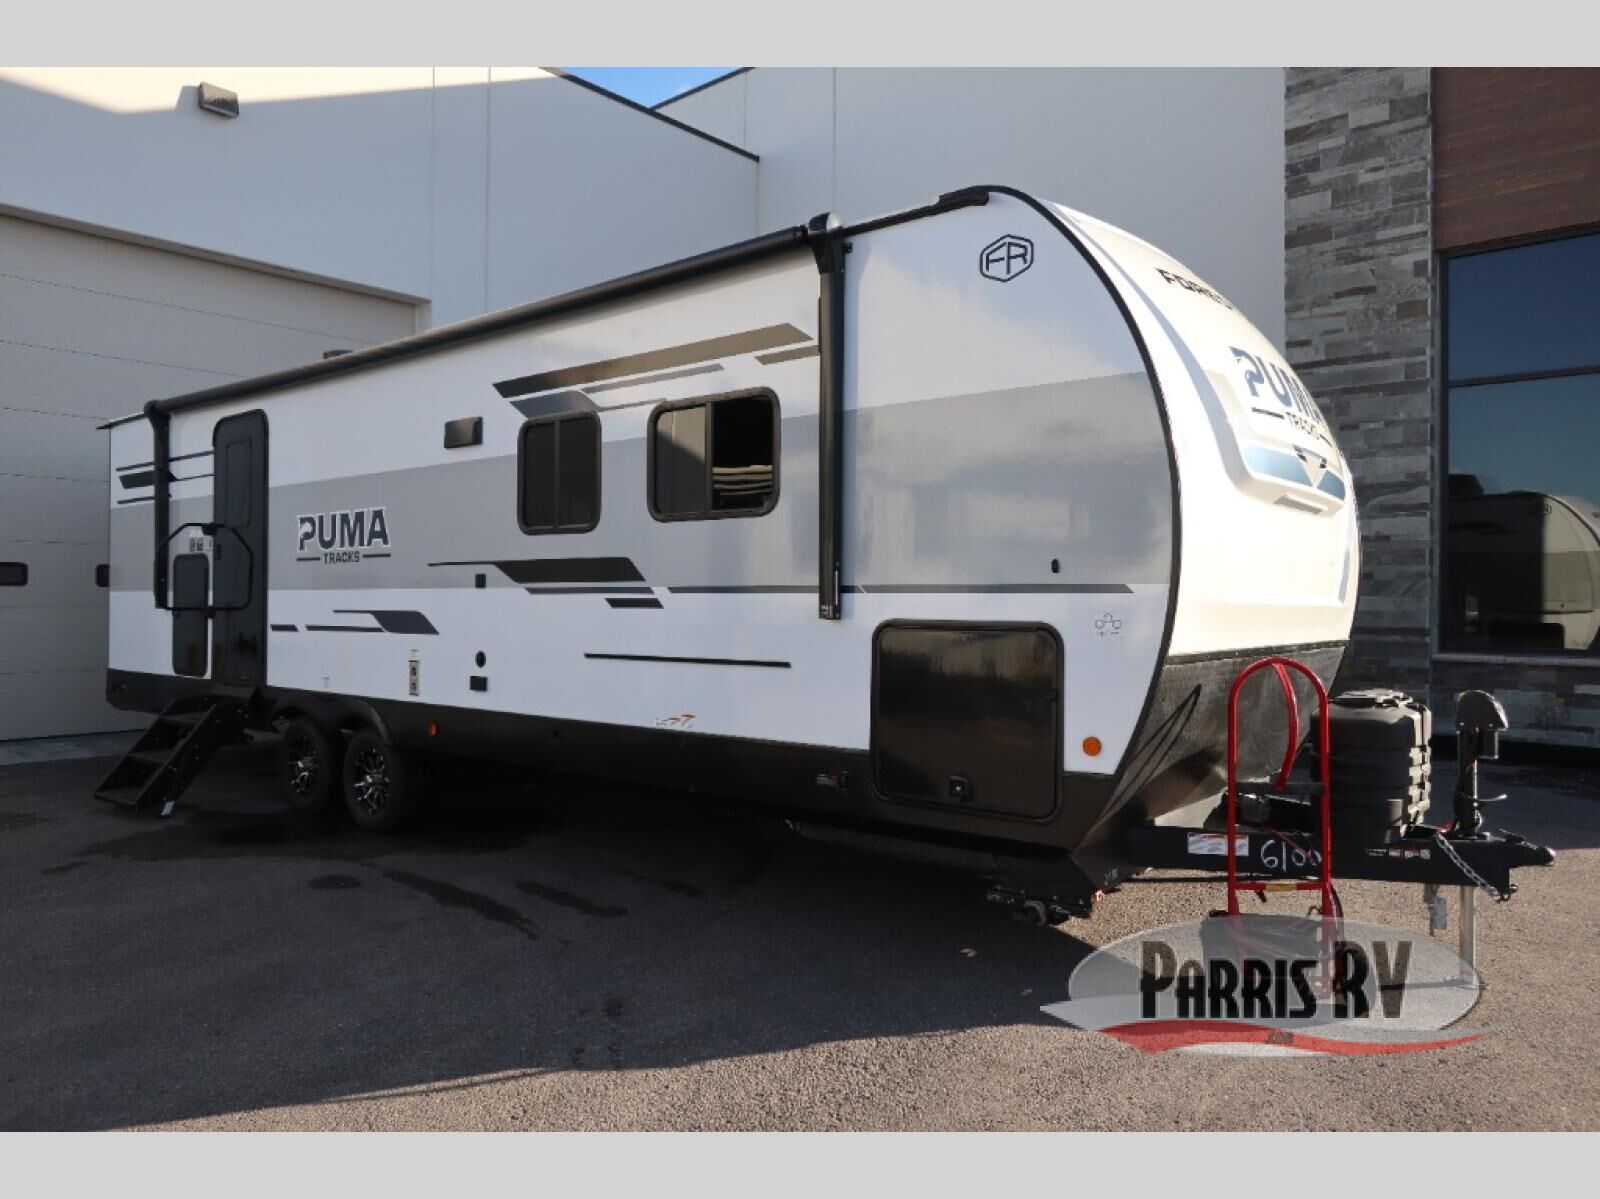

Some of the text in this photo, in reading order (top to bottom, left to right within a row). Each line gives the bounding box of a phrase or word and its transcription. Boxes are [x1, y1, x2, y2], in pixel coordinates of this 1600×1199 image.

[984, 240, 1028, 275] FR
[298, 507, 390, 551] PUMA
[323, 551, 360, 564] TRACKS
